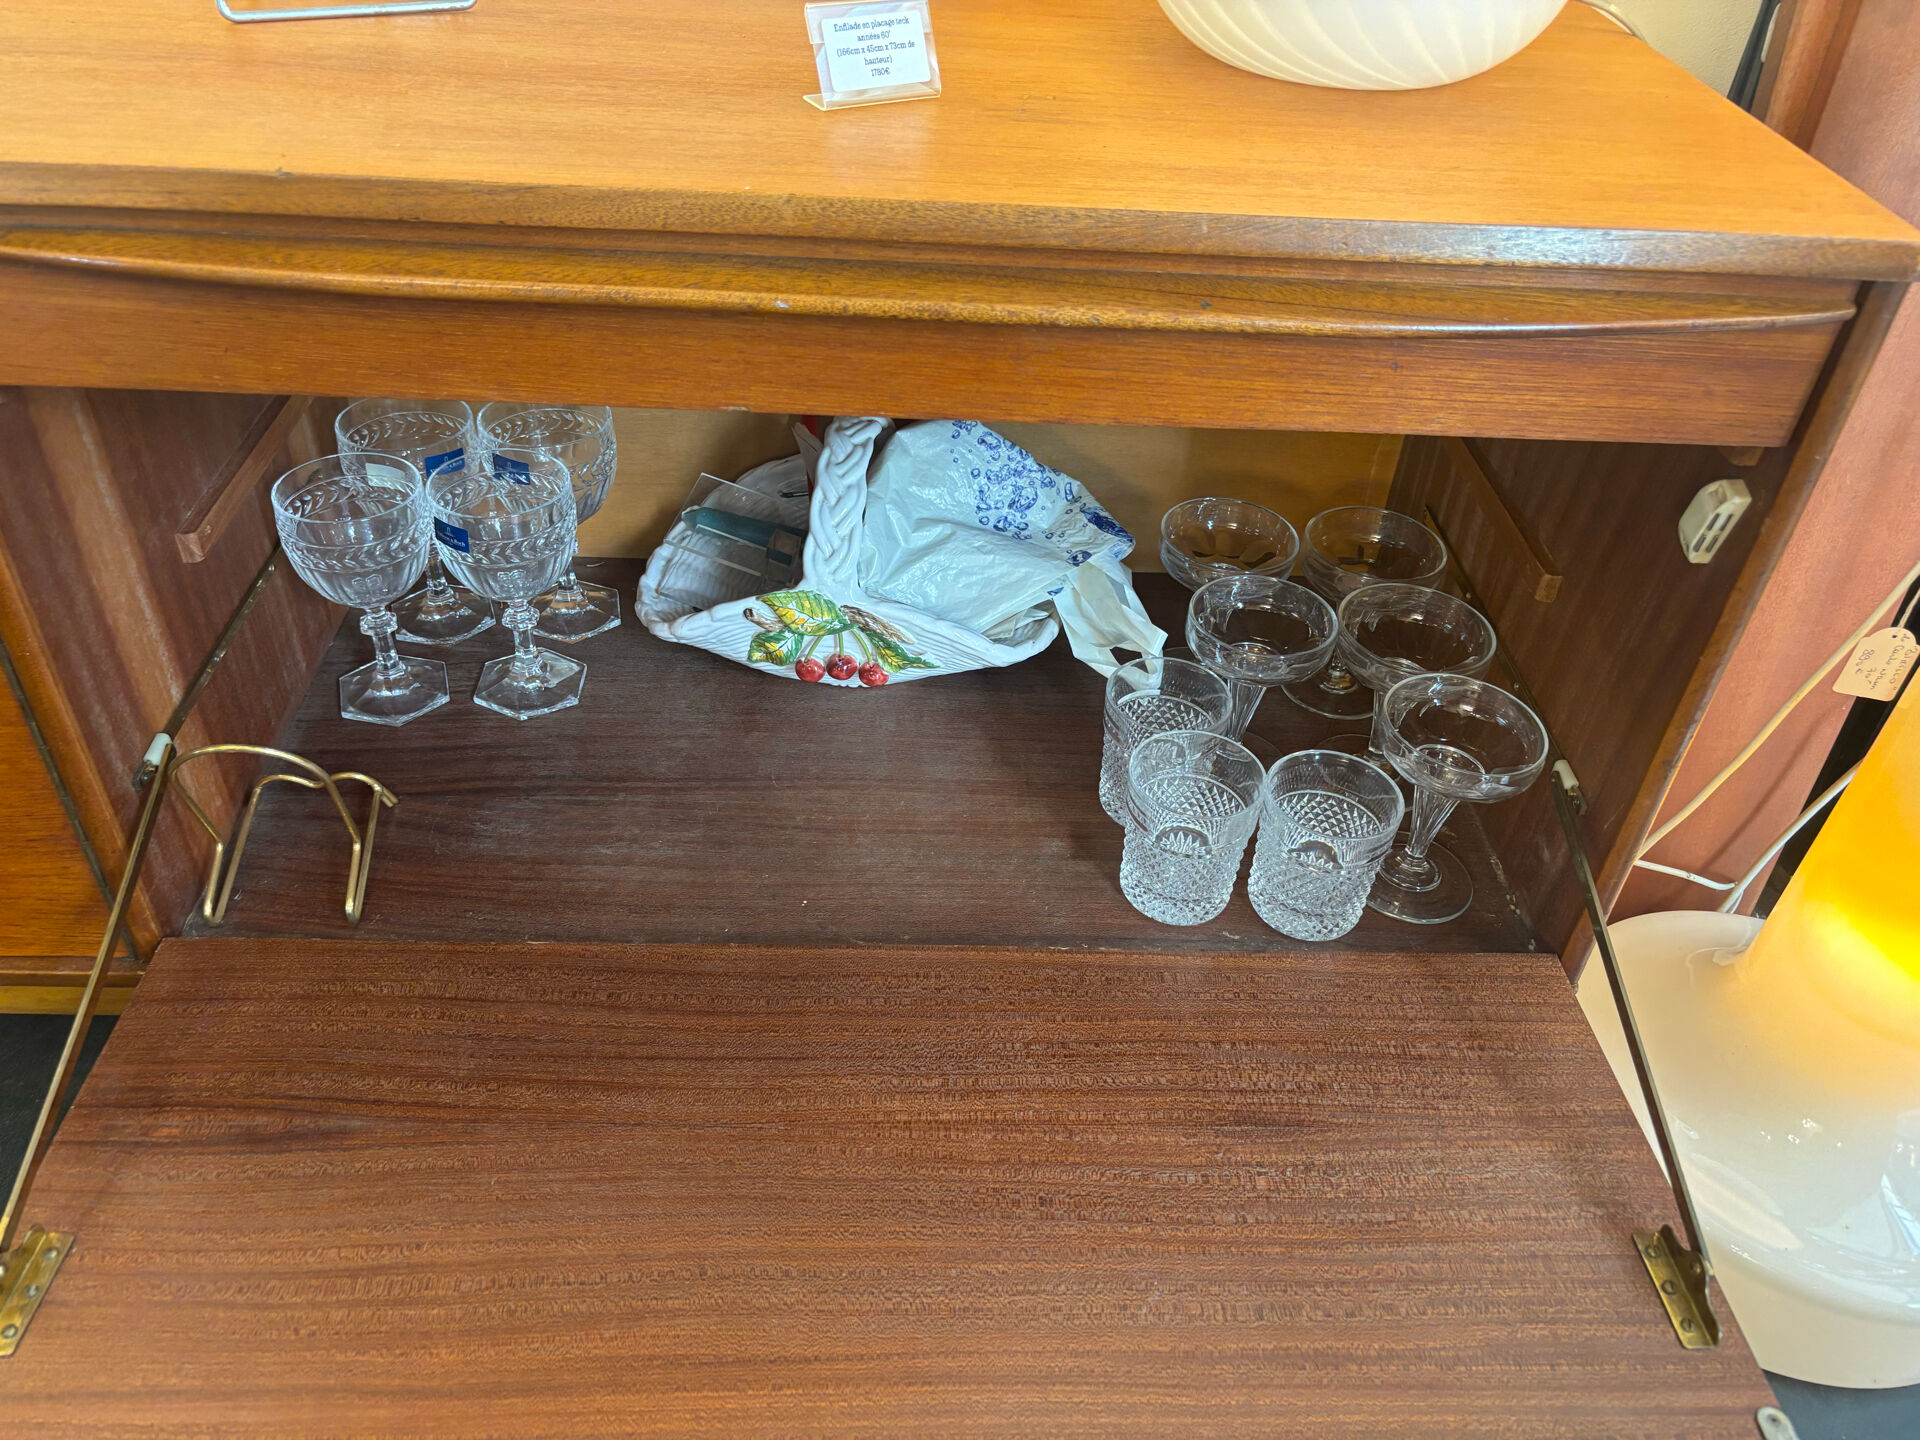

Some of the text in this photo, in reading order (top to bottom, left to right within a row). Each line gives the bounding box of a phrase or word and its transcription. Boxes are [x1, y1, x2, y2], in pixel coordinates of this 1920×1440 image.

[834, 22, 861, 32] Enfilade
[871, 20, 895, 29] placage
[895, 16, 910, 25] teck
[857, 33, 880, 41] années
[866, 44, 884, 53] 45cm
[889, 41, 907, 50] 73cm
[864, 55, 892, 65] hauteur)
